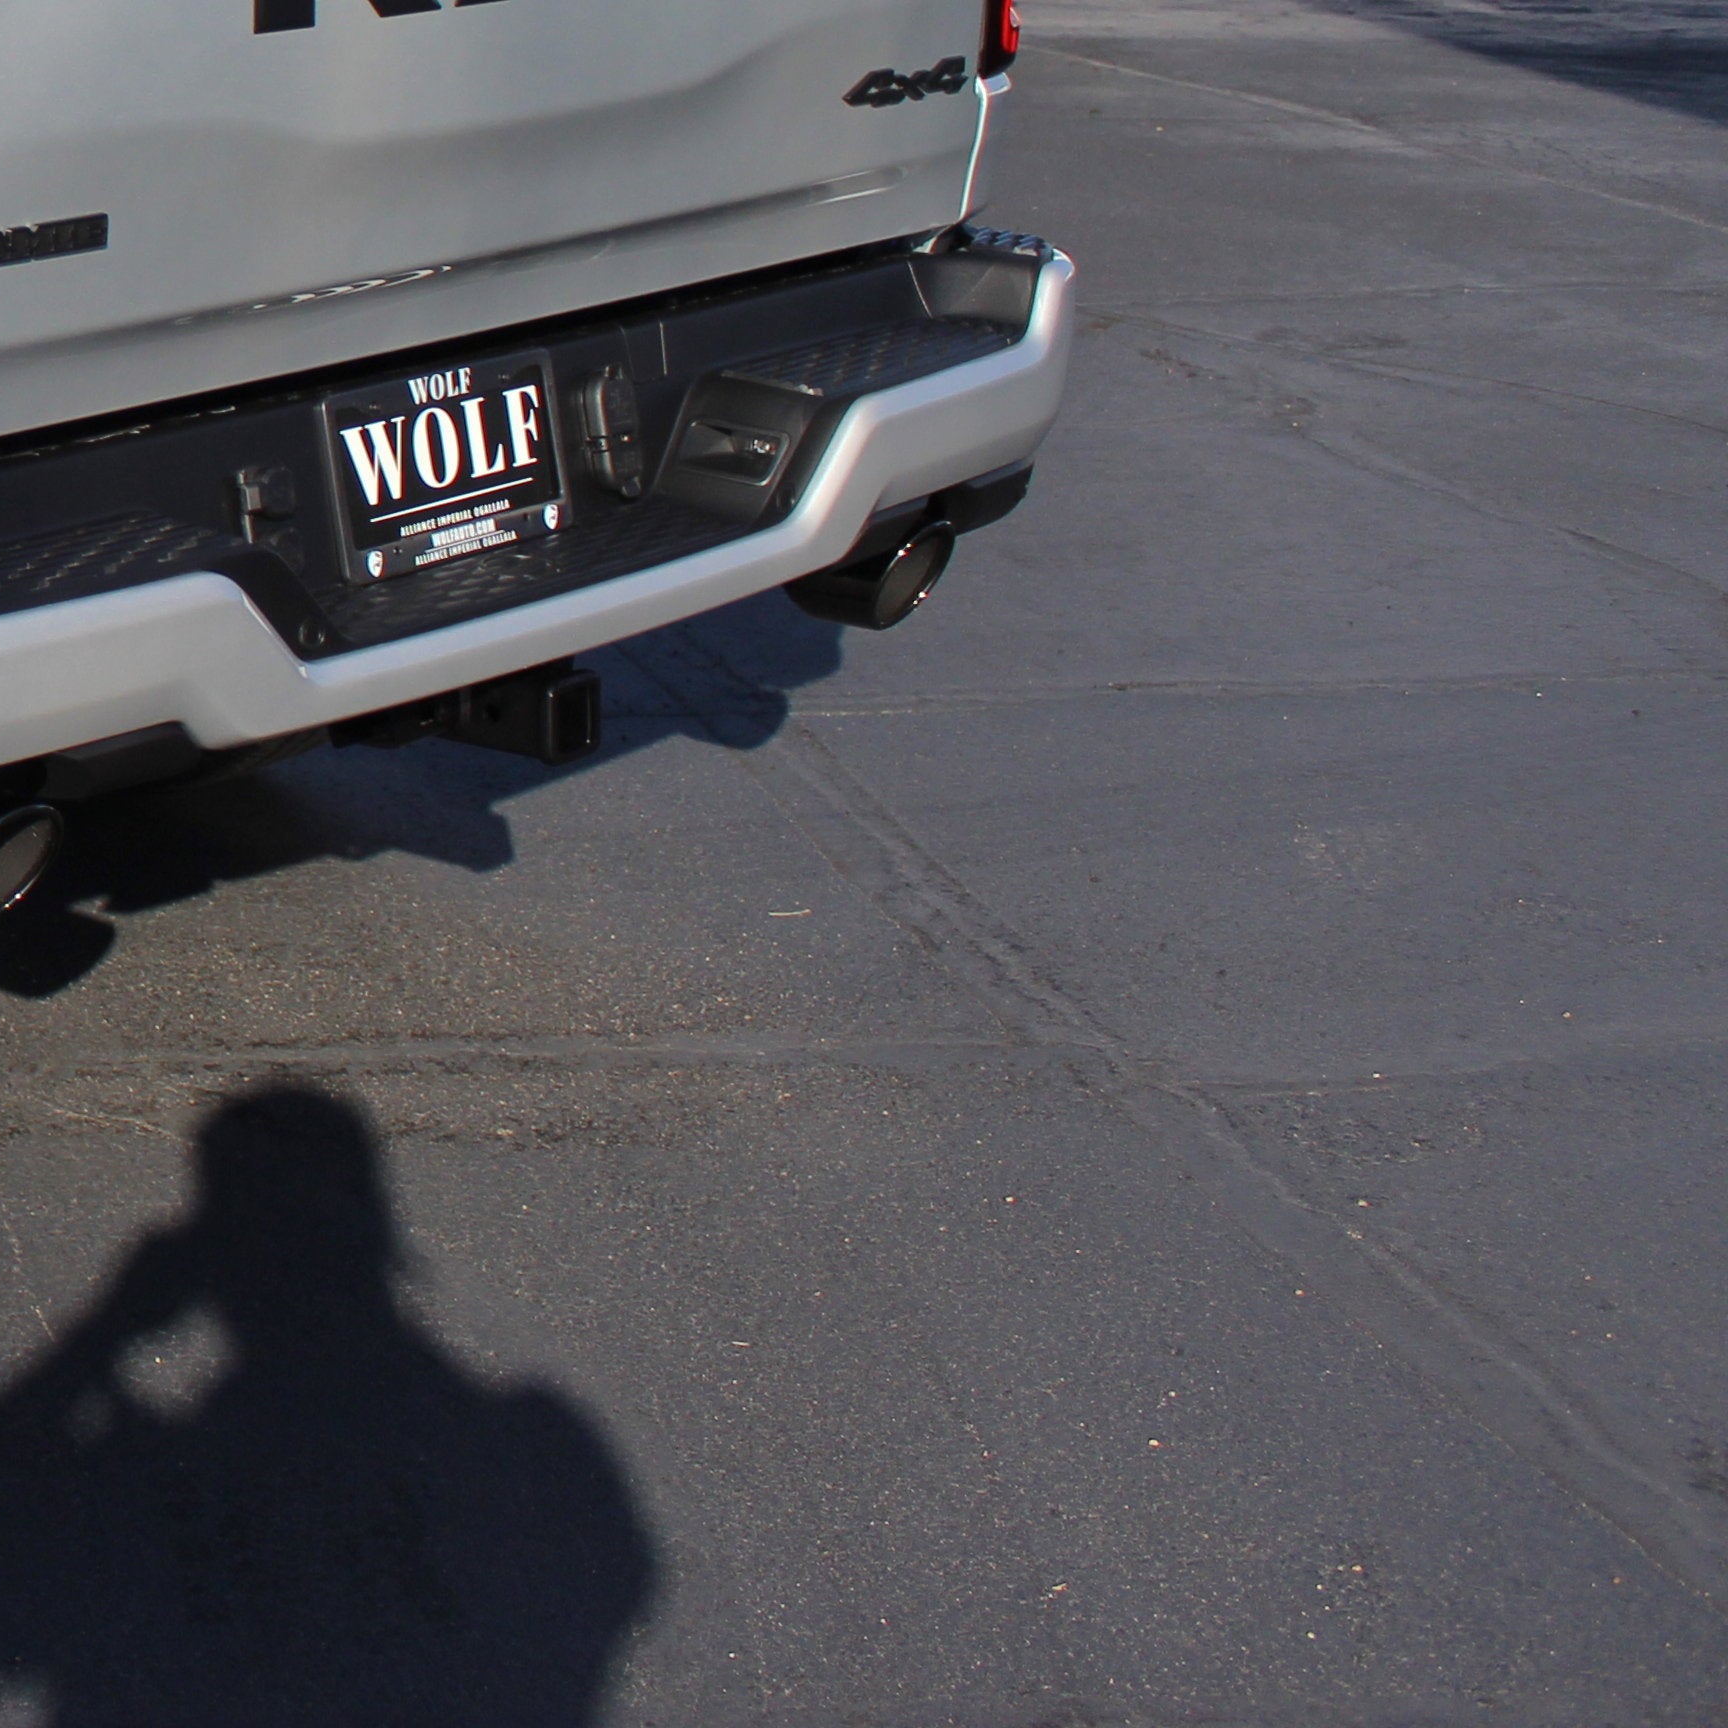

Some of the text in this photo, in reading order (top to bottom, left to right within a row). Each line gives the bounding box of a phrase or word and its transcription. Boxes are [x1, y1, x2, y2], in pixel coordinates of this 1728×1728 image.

[408, 367, 471, 405] WOLF
[339, 384, 542, 506] WOLF
[400, 499, 510, 537] ALLIANCE IMPERIAL OGALLALA
[431, 518, 497, 547] WOLFAUTO.COM
[415, 530, 518, 566] ALLIANCE IMPERIAL OGALLALA
